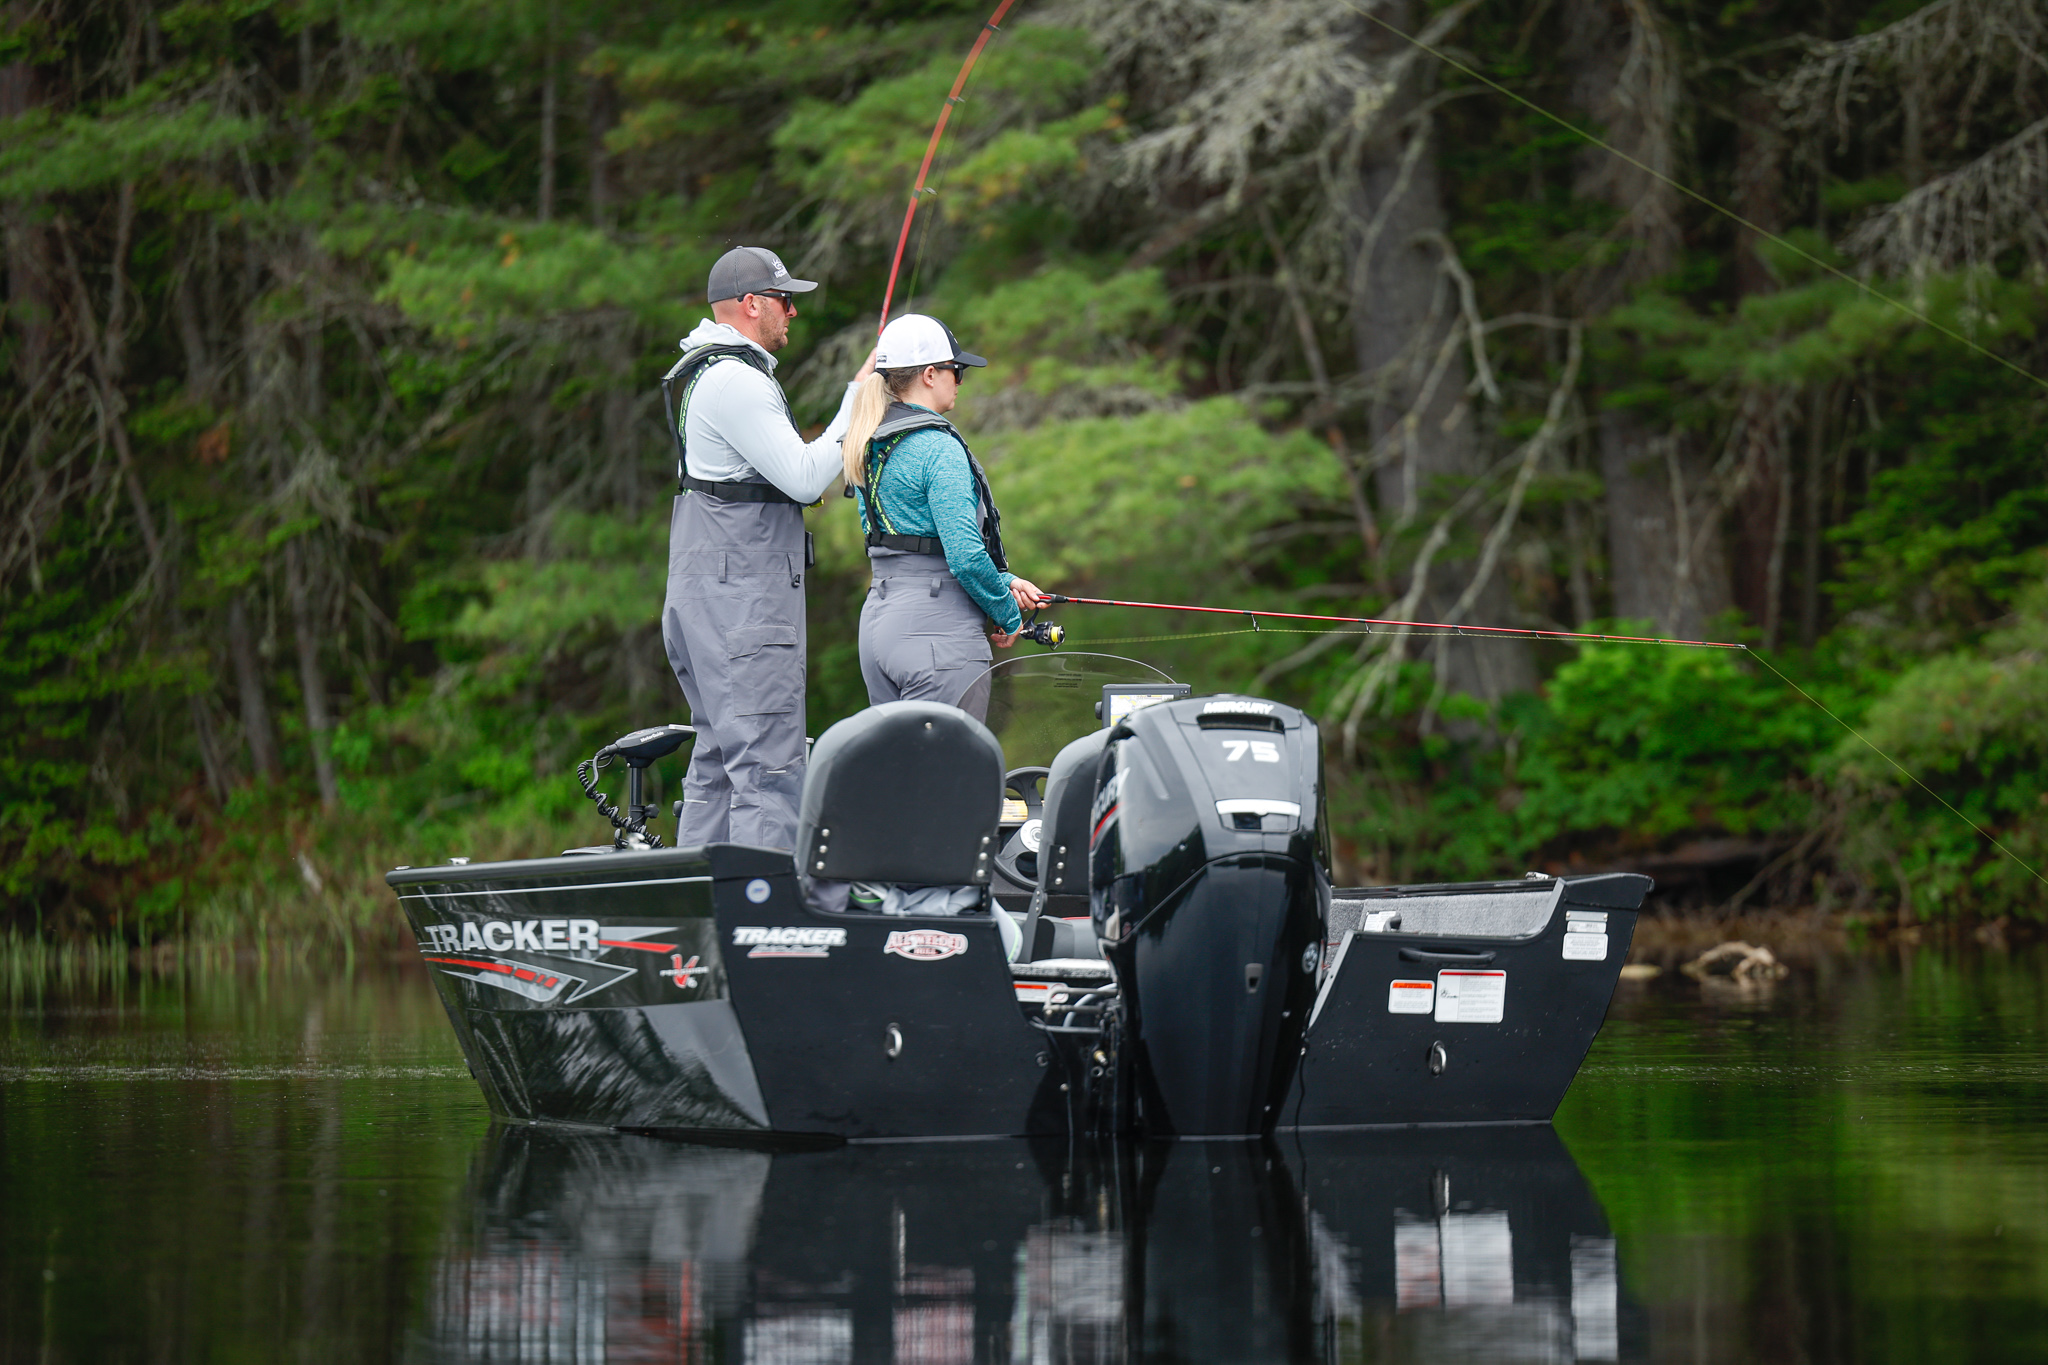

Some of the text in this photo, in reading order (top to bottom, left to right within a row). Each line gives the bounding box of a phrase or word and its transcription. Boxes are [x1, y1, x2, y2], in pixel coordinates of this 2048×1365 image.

[1203, 701, 1275, 715] MERCURY
[1222, 740, 1280, 764] 75
[424, 919, 600, 952] TRACKER
[732, 926, 848, 946] TRACKER
